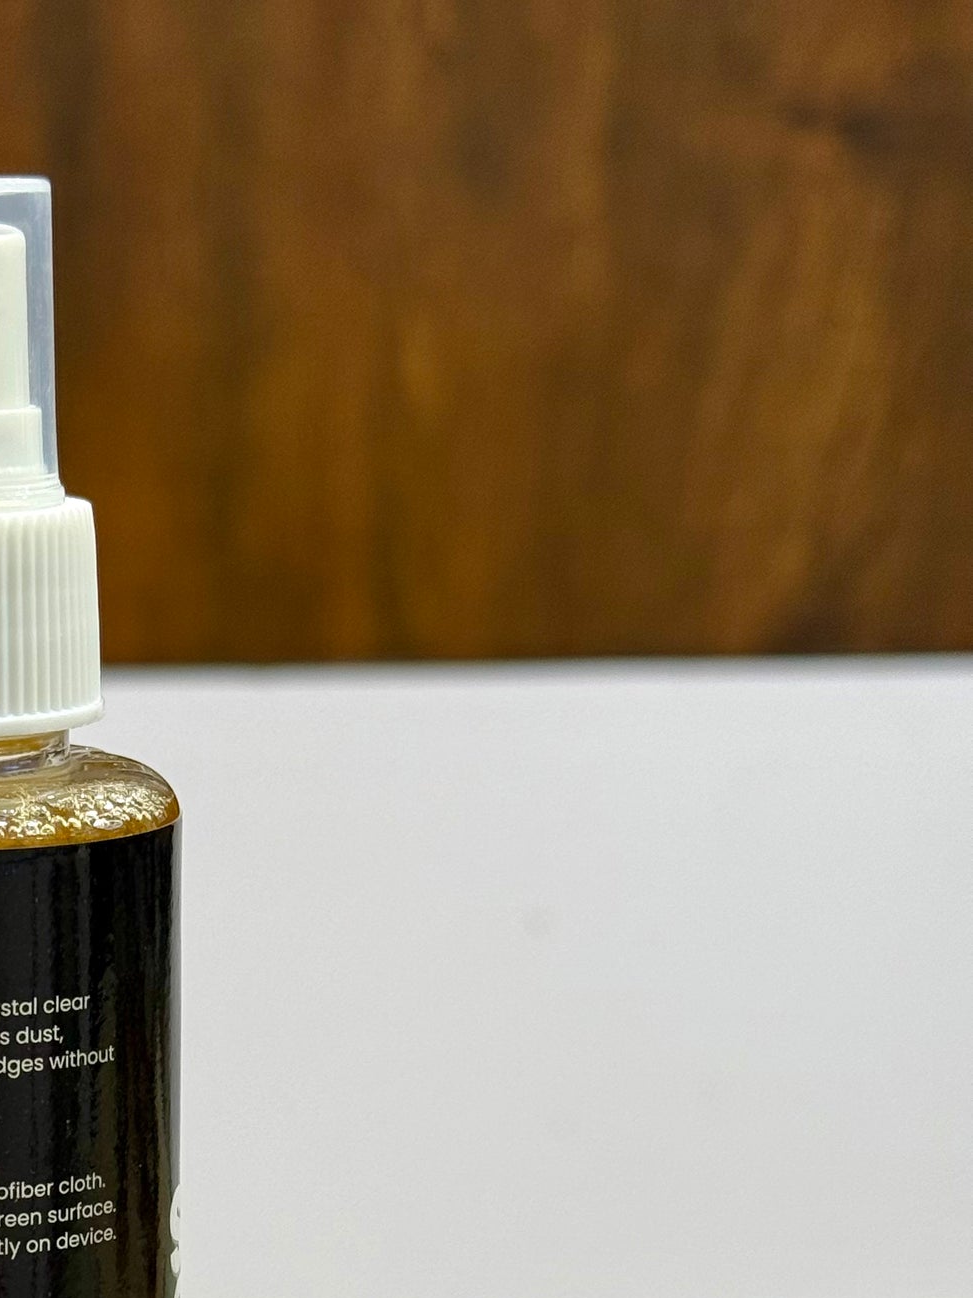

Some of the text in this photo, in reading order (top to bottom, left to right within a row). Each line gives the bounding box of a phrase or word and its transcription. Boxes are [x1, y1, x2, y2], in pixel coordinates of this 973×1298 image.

[42, 994, 91, 1014] clear
[15, 1024, 64, 1045] dust,
[48, 1044, 115, 1070] without
[58, 1172, 106, 1195] cloth.
[47, 1200, 117, 1224] surface.
[25, 1237, 51, 1254] on
[55, 1226, 117, 1250] device.
